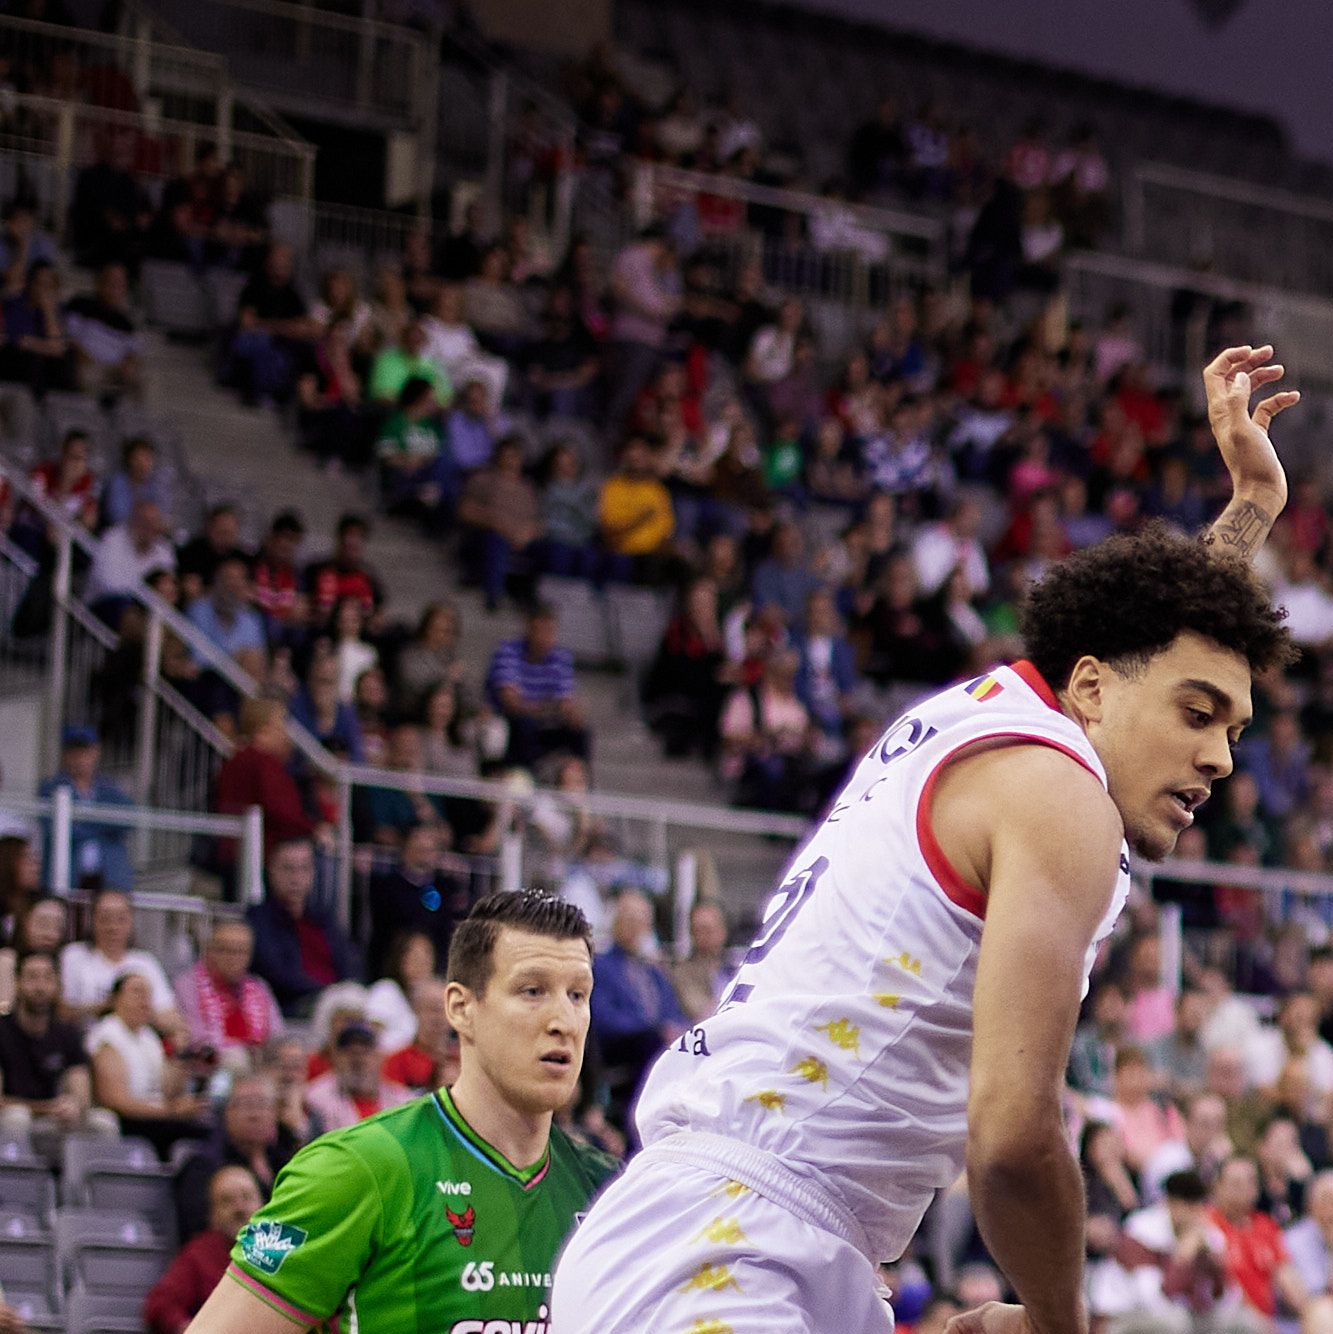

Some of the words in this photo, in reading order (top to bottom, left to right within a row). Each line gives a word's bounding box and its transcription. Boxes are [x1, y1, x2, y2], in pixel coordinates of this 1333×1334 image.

[435, 1181, 472, 1196] vive
[461, 1261, 495, 1292] 65
[499, 1272, 553, 1288] ANIVE
